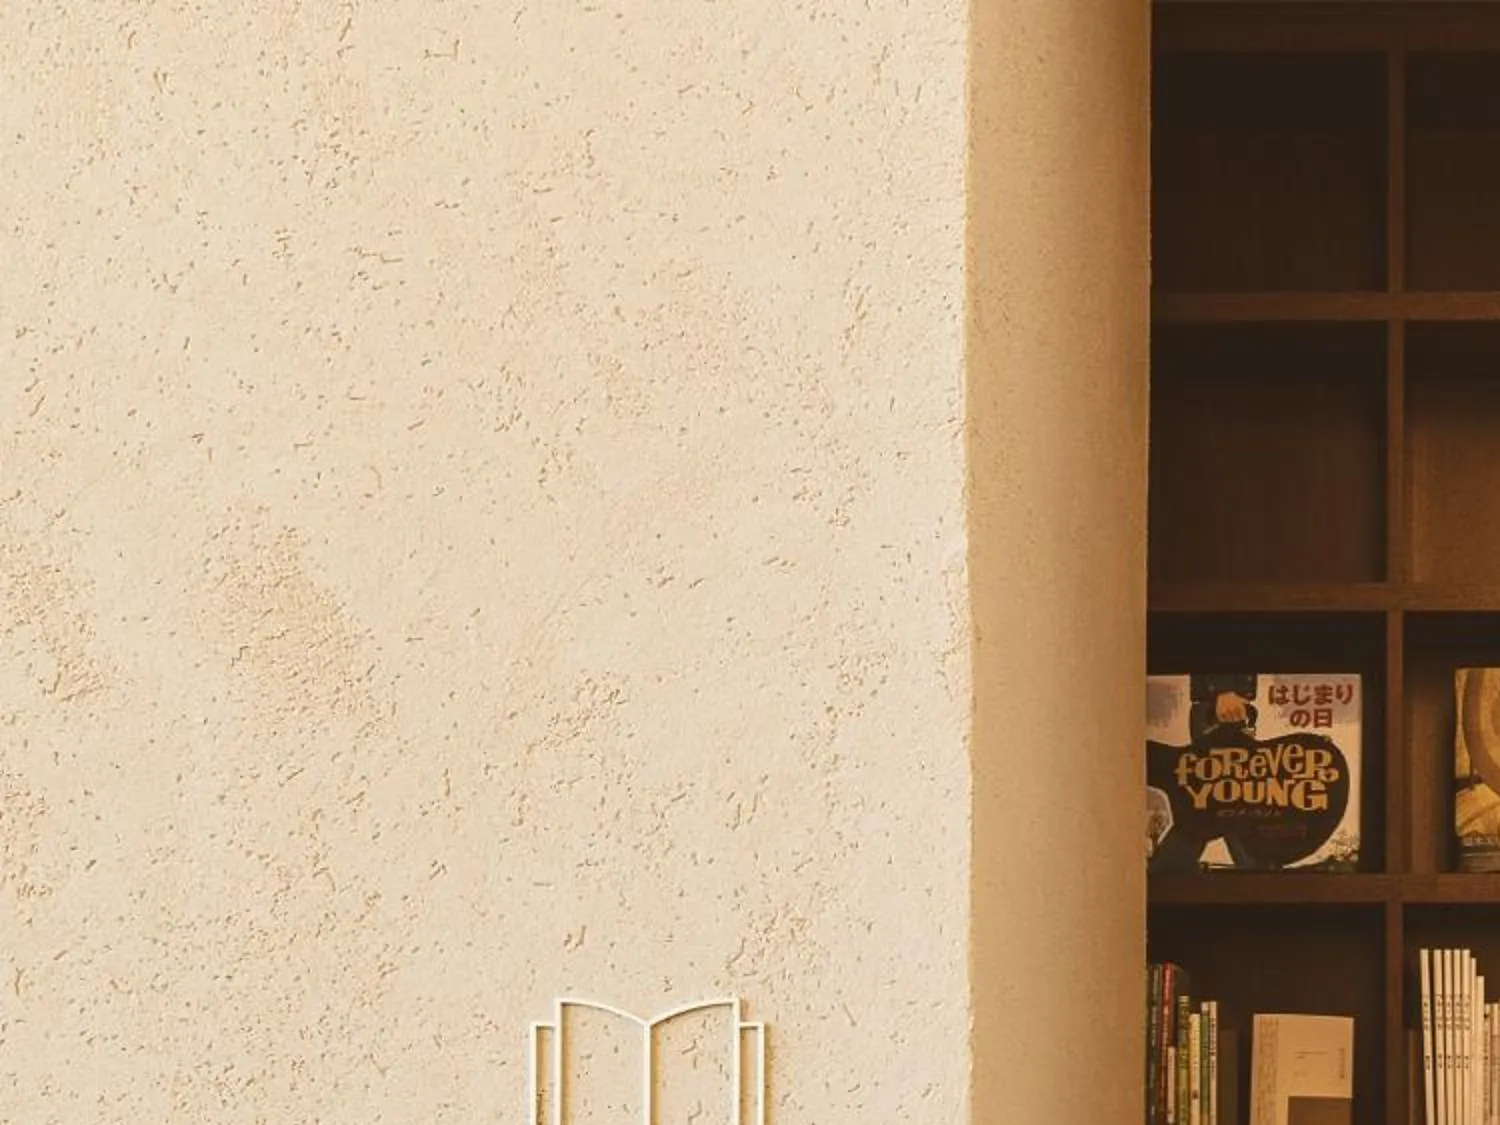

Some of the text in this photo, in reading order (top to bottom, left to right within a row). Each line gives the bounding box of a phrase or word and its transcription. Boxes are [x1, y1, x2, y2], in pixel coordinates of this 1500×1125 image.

[1267, 684, 1353, 705] はじまり
[1290, 708, 1333, 728] の日
